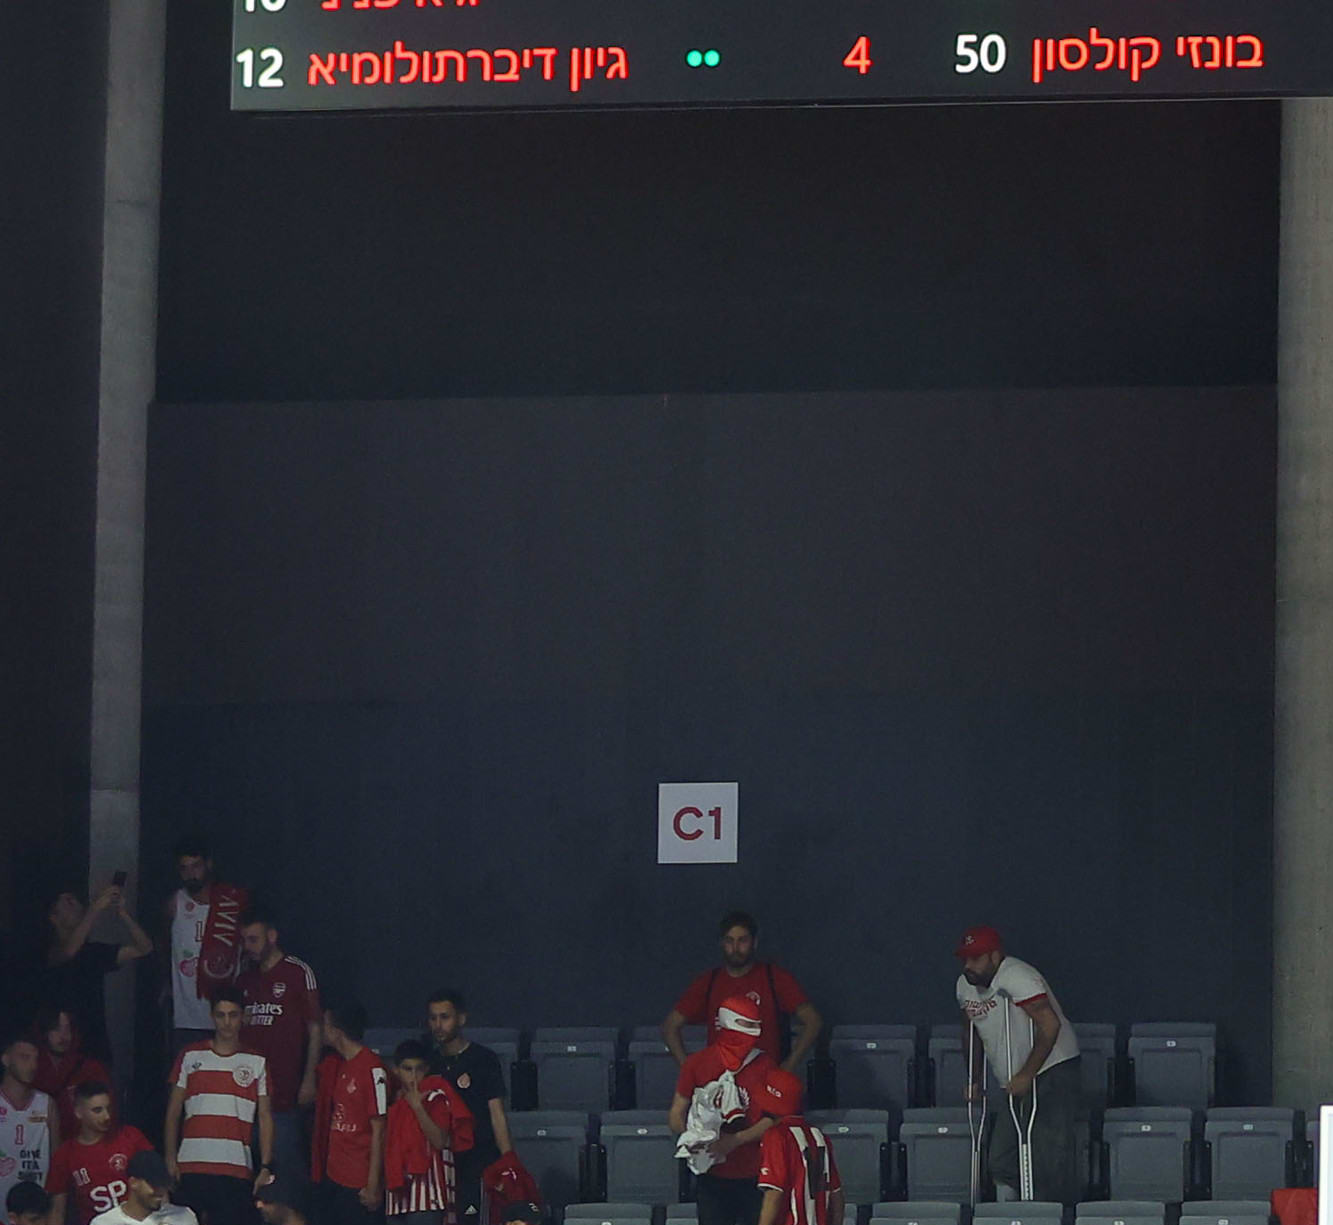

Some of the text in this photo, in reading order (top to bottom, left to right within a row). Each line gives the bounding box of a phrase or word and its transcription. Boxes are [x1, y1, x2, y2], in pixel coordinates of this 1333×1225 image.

[236, 37, 873, 92] 12 גיון דיברתולומיא 4
[954, 34, 1007, 74] 50
[1032, 28, 1162, 84] קולסון
[1177, 35, 1264, 70] בונזי
[673, 806, 722, 841] C1
